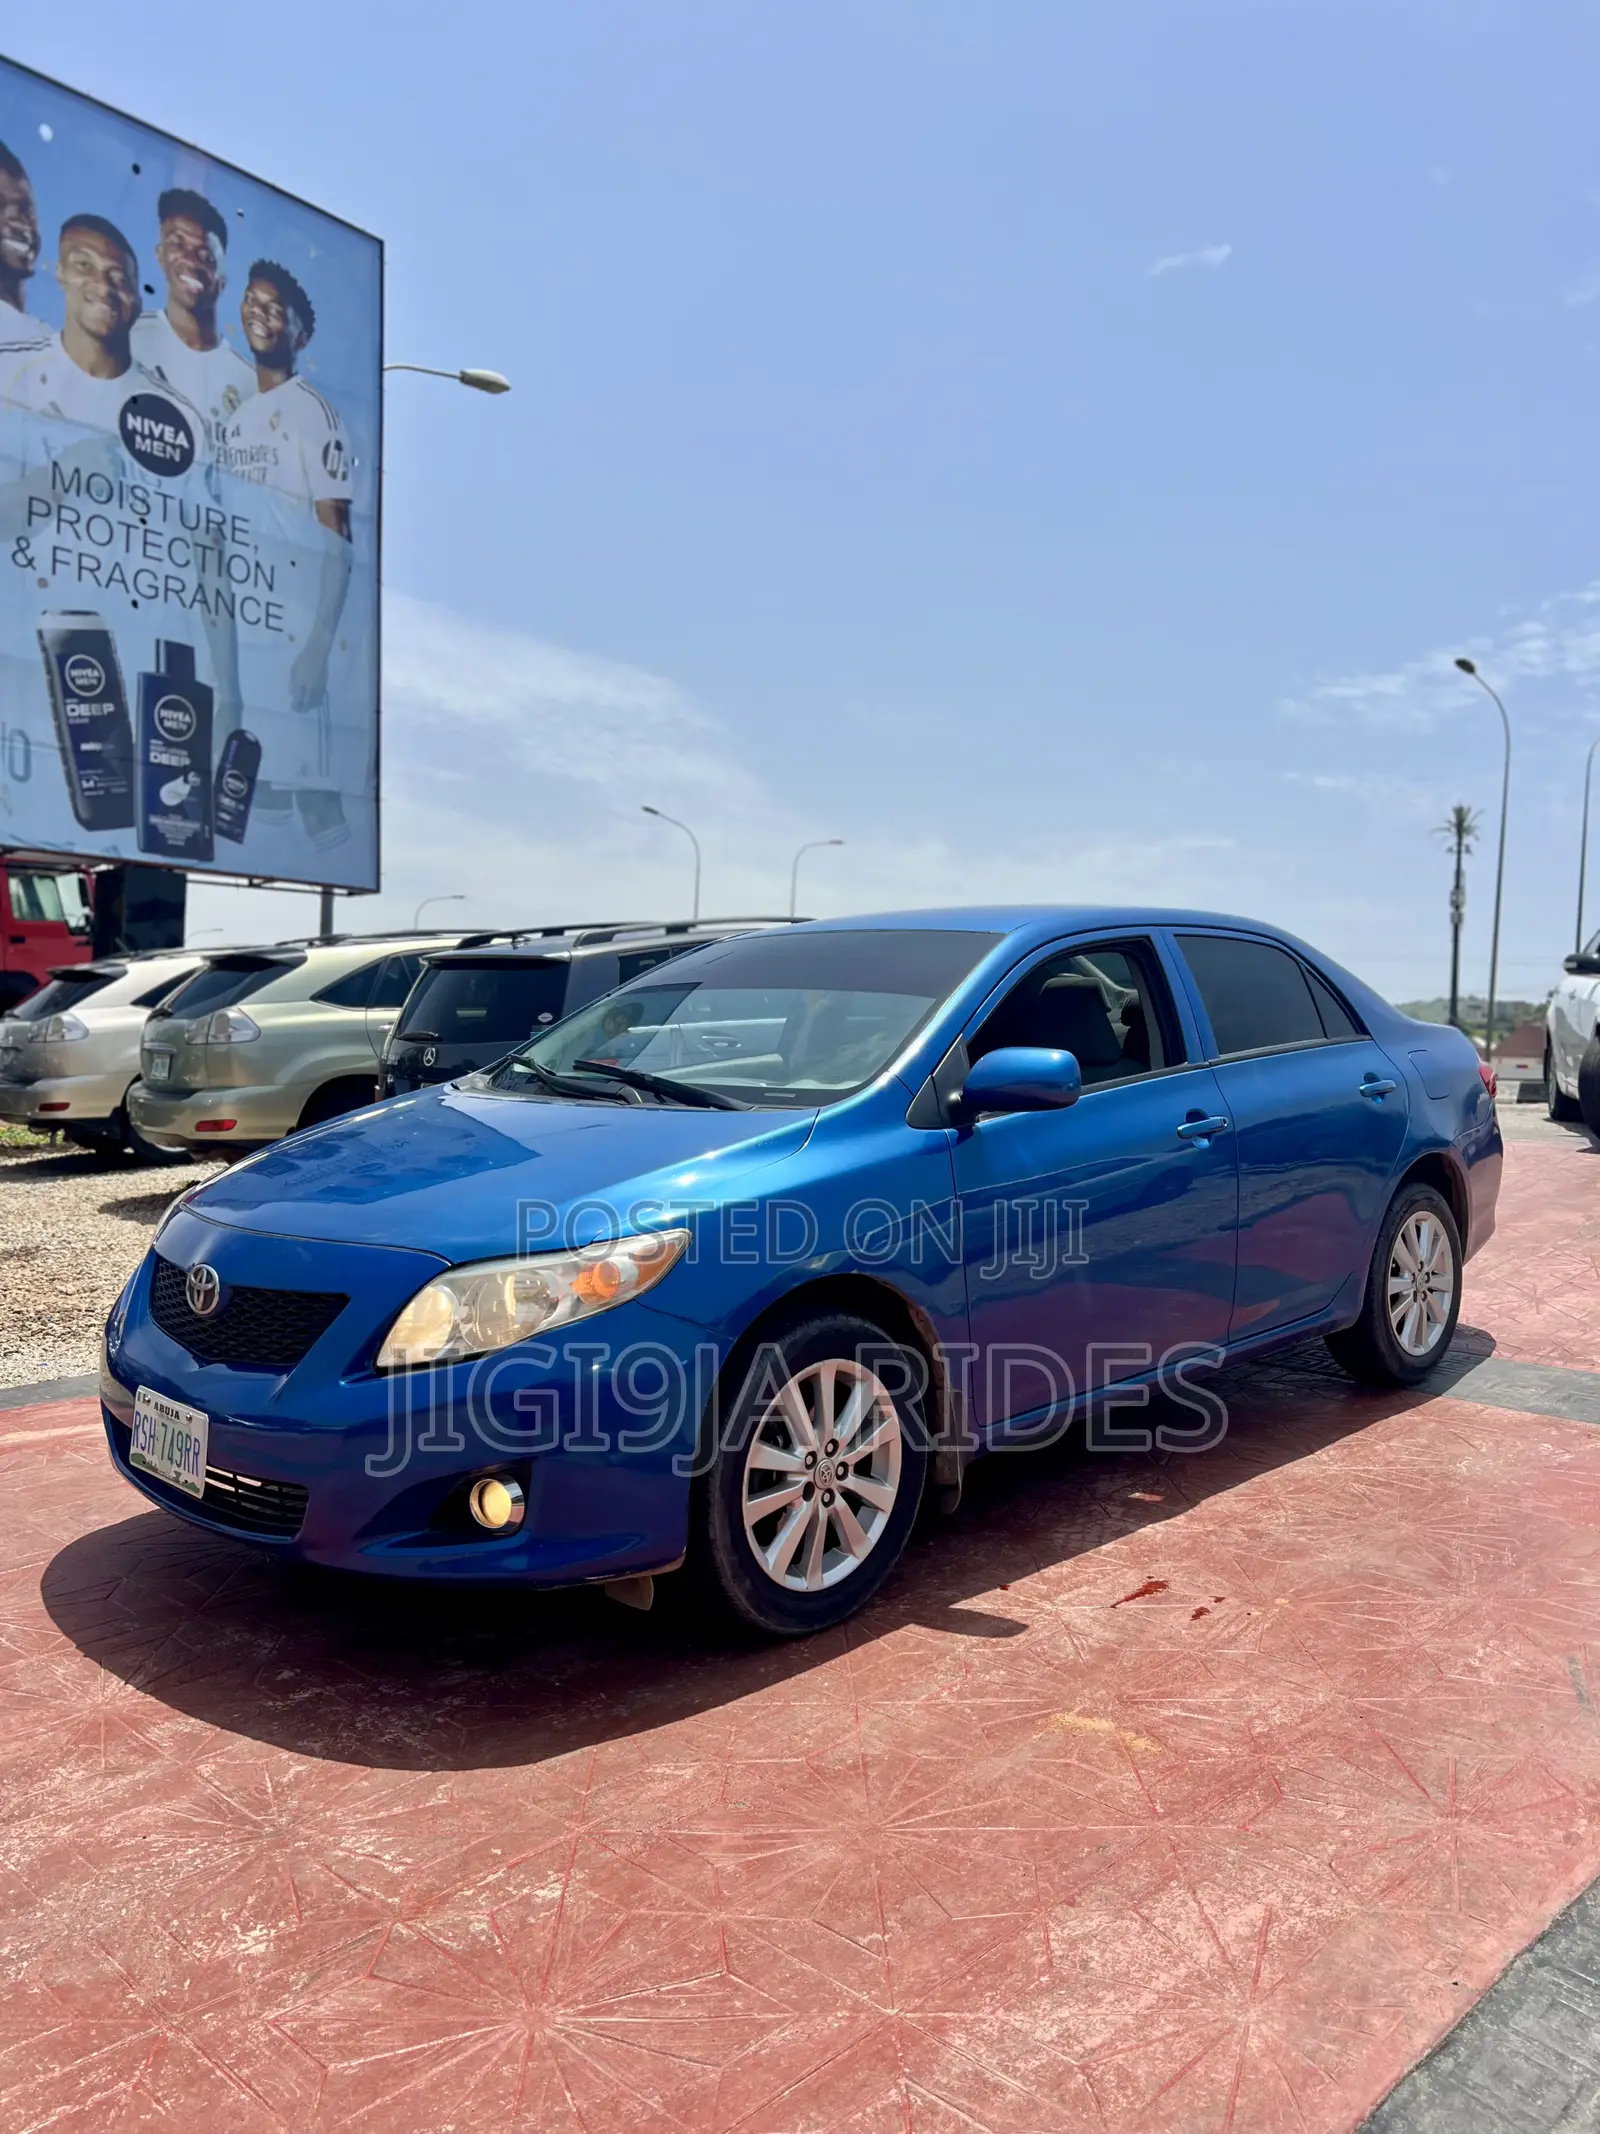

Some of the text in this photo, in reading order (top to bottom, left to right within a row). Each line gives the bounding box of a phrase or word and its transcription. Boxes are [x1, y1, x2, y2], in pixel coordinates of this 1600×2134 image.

[126, 412, 190, 449] NIVEA
[135, 435, 182, 463] MEN
[51, 461, 259, 553] MOISTURE,
[27, 496, 276, 593] PROTECTION
[11, 535, 285, 632] & FRAGRANCE
[70, 668, 100, 678] NIVEA
[66, 702, 115, 717] DEEP
[159, 708, 192, 724] NIVEA
[163, 719, 188, 732] MEN
[154, 1401, 180, 1420] ABUJA
